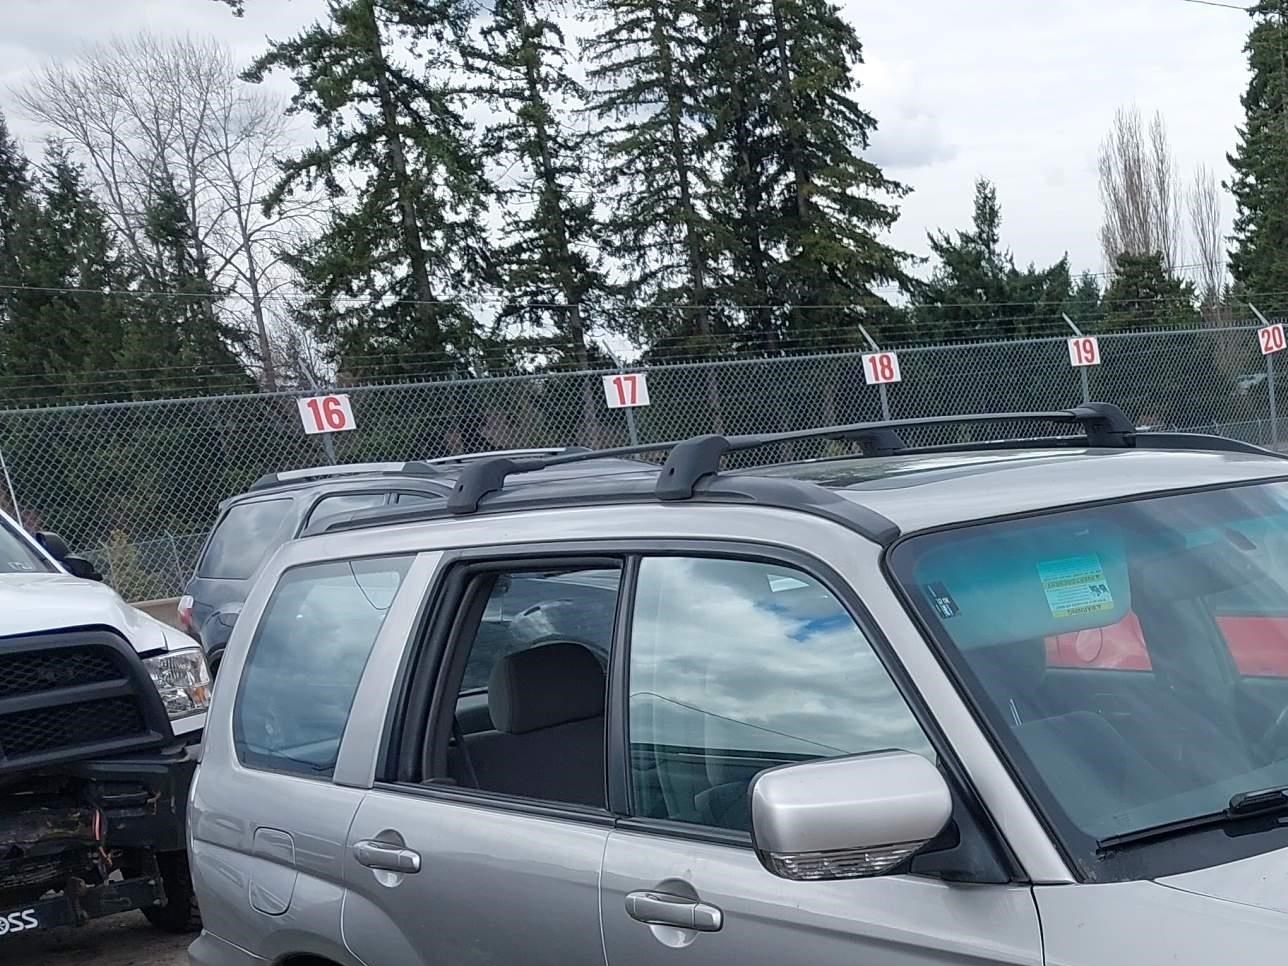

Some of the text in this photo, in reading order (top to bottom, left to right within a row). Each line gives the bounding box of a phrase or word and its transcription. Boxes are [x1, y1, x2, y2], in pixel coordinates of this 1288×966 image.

[1073, 339, 1095, 364] 19
[1261, 326, 1283, 352] 20
[869, 354, 894, 381] 18
[613, 375, 637, 405] 17
[307, 396, 346, 431] 16
